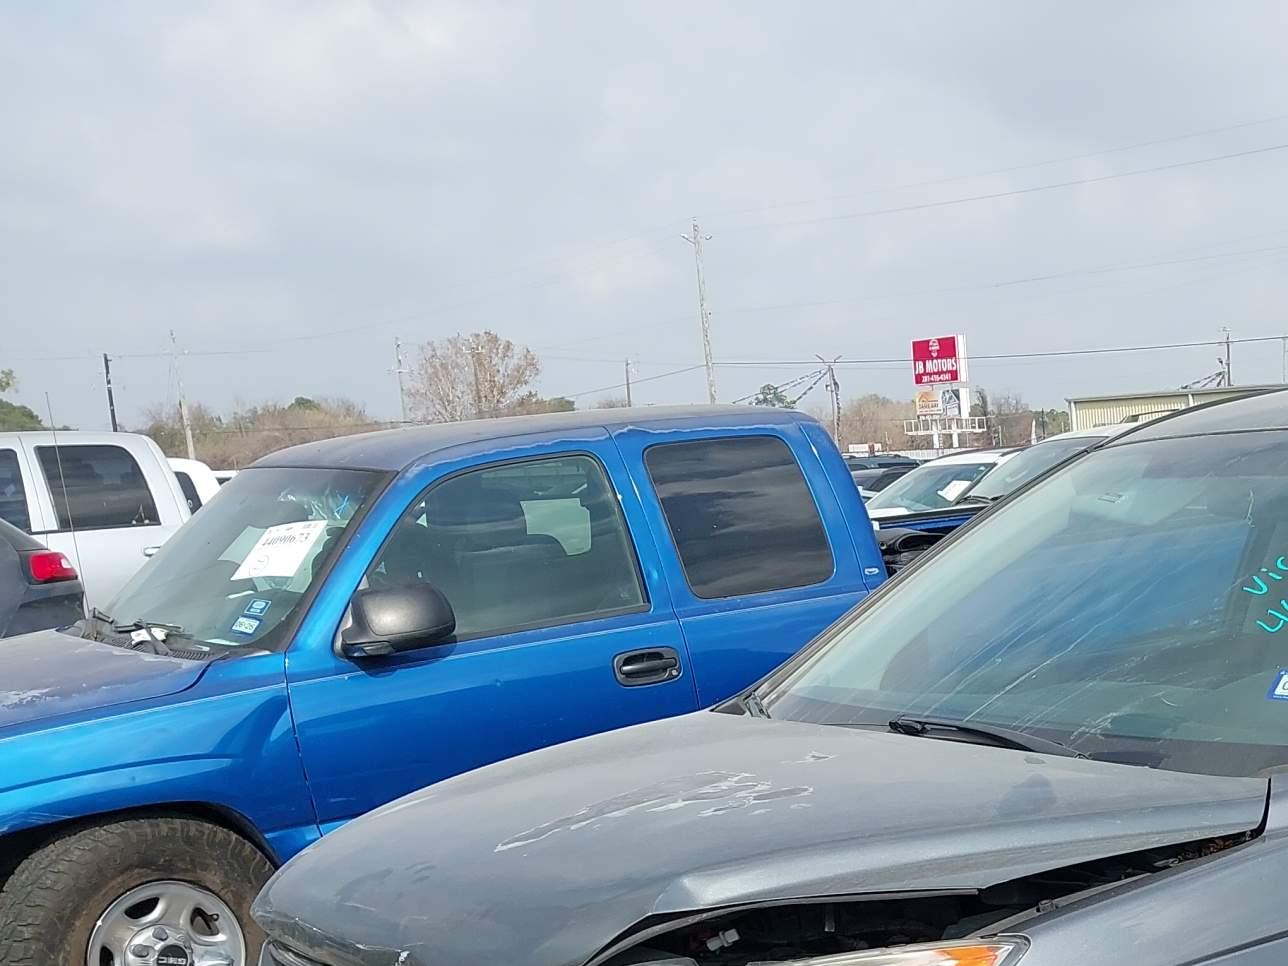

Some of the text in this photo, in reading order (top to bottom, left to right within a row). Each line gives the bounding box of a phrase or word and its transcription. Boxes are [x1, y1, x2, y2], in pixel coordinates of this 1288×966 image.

[915, 357, 956, 374] JB MOTORS
[158, 956, 187, 965] GMC
